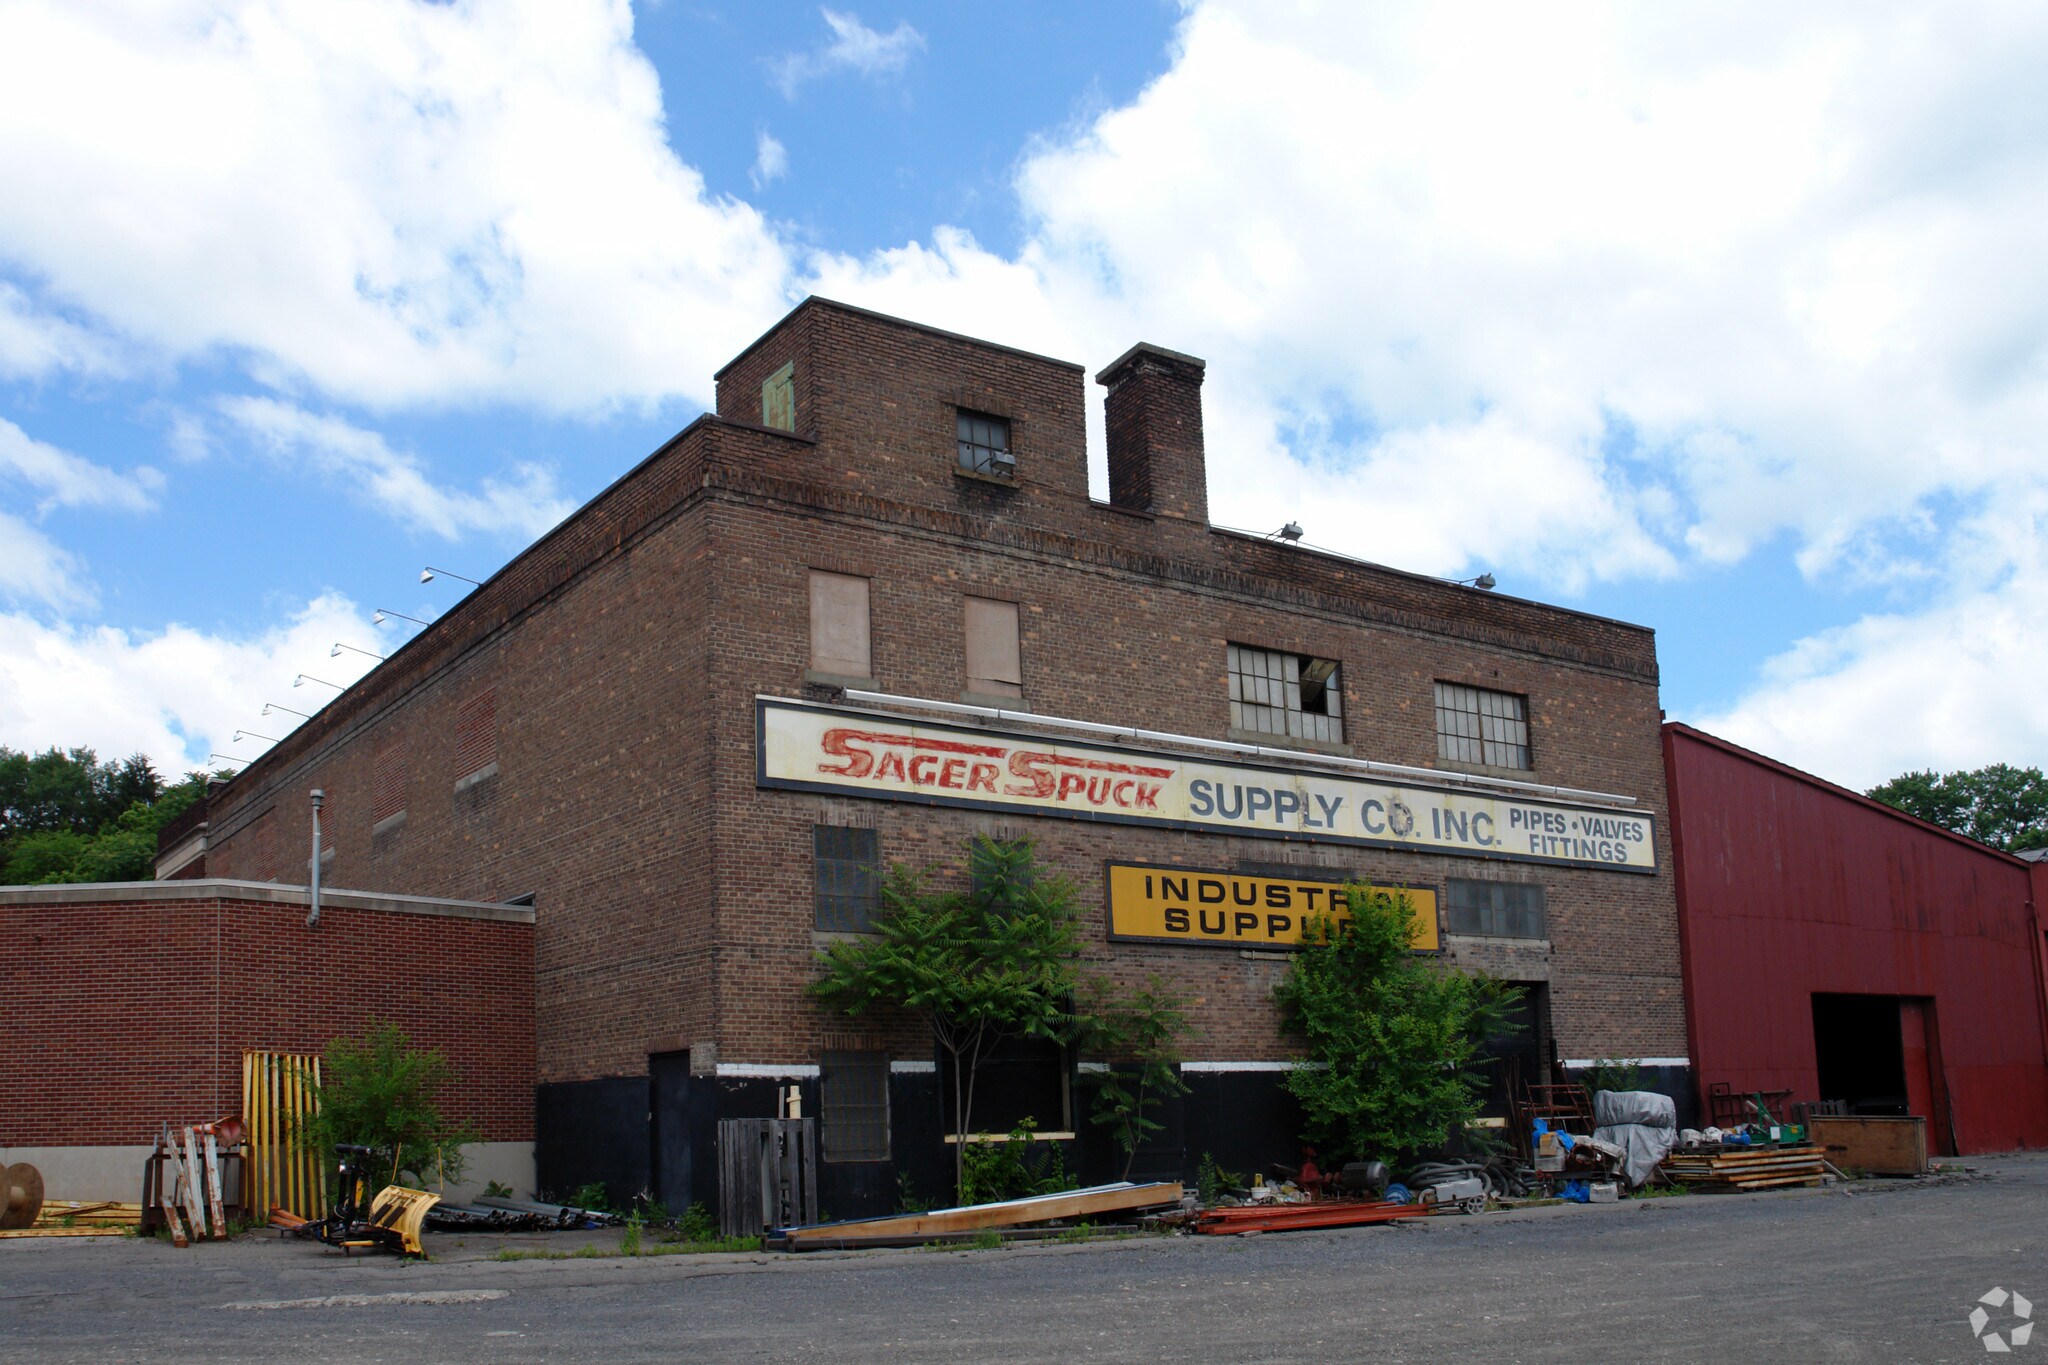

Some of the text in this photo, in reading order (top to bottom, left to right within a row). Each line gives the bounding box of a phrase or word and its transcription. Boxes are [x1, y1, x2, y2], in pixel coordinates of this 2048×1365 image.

[816, 727, 1502, 846] SAGER SPUCK SUPPLY CO. INC.
[1509, 807, 1643, 842] PIPES VALVES
[1529, 834, 1628, 863] FITTINGS
[1165, 907, 1364, 947] SUPPLI
